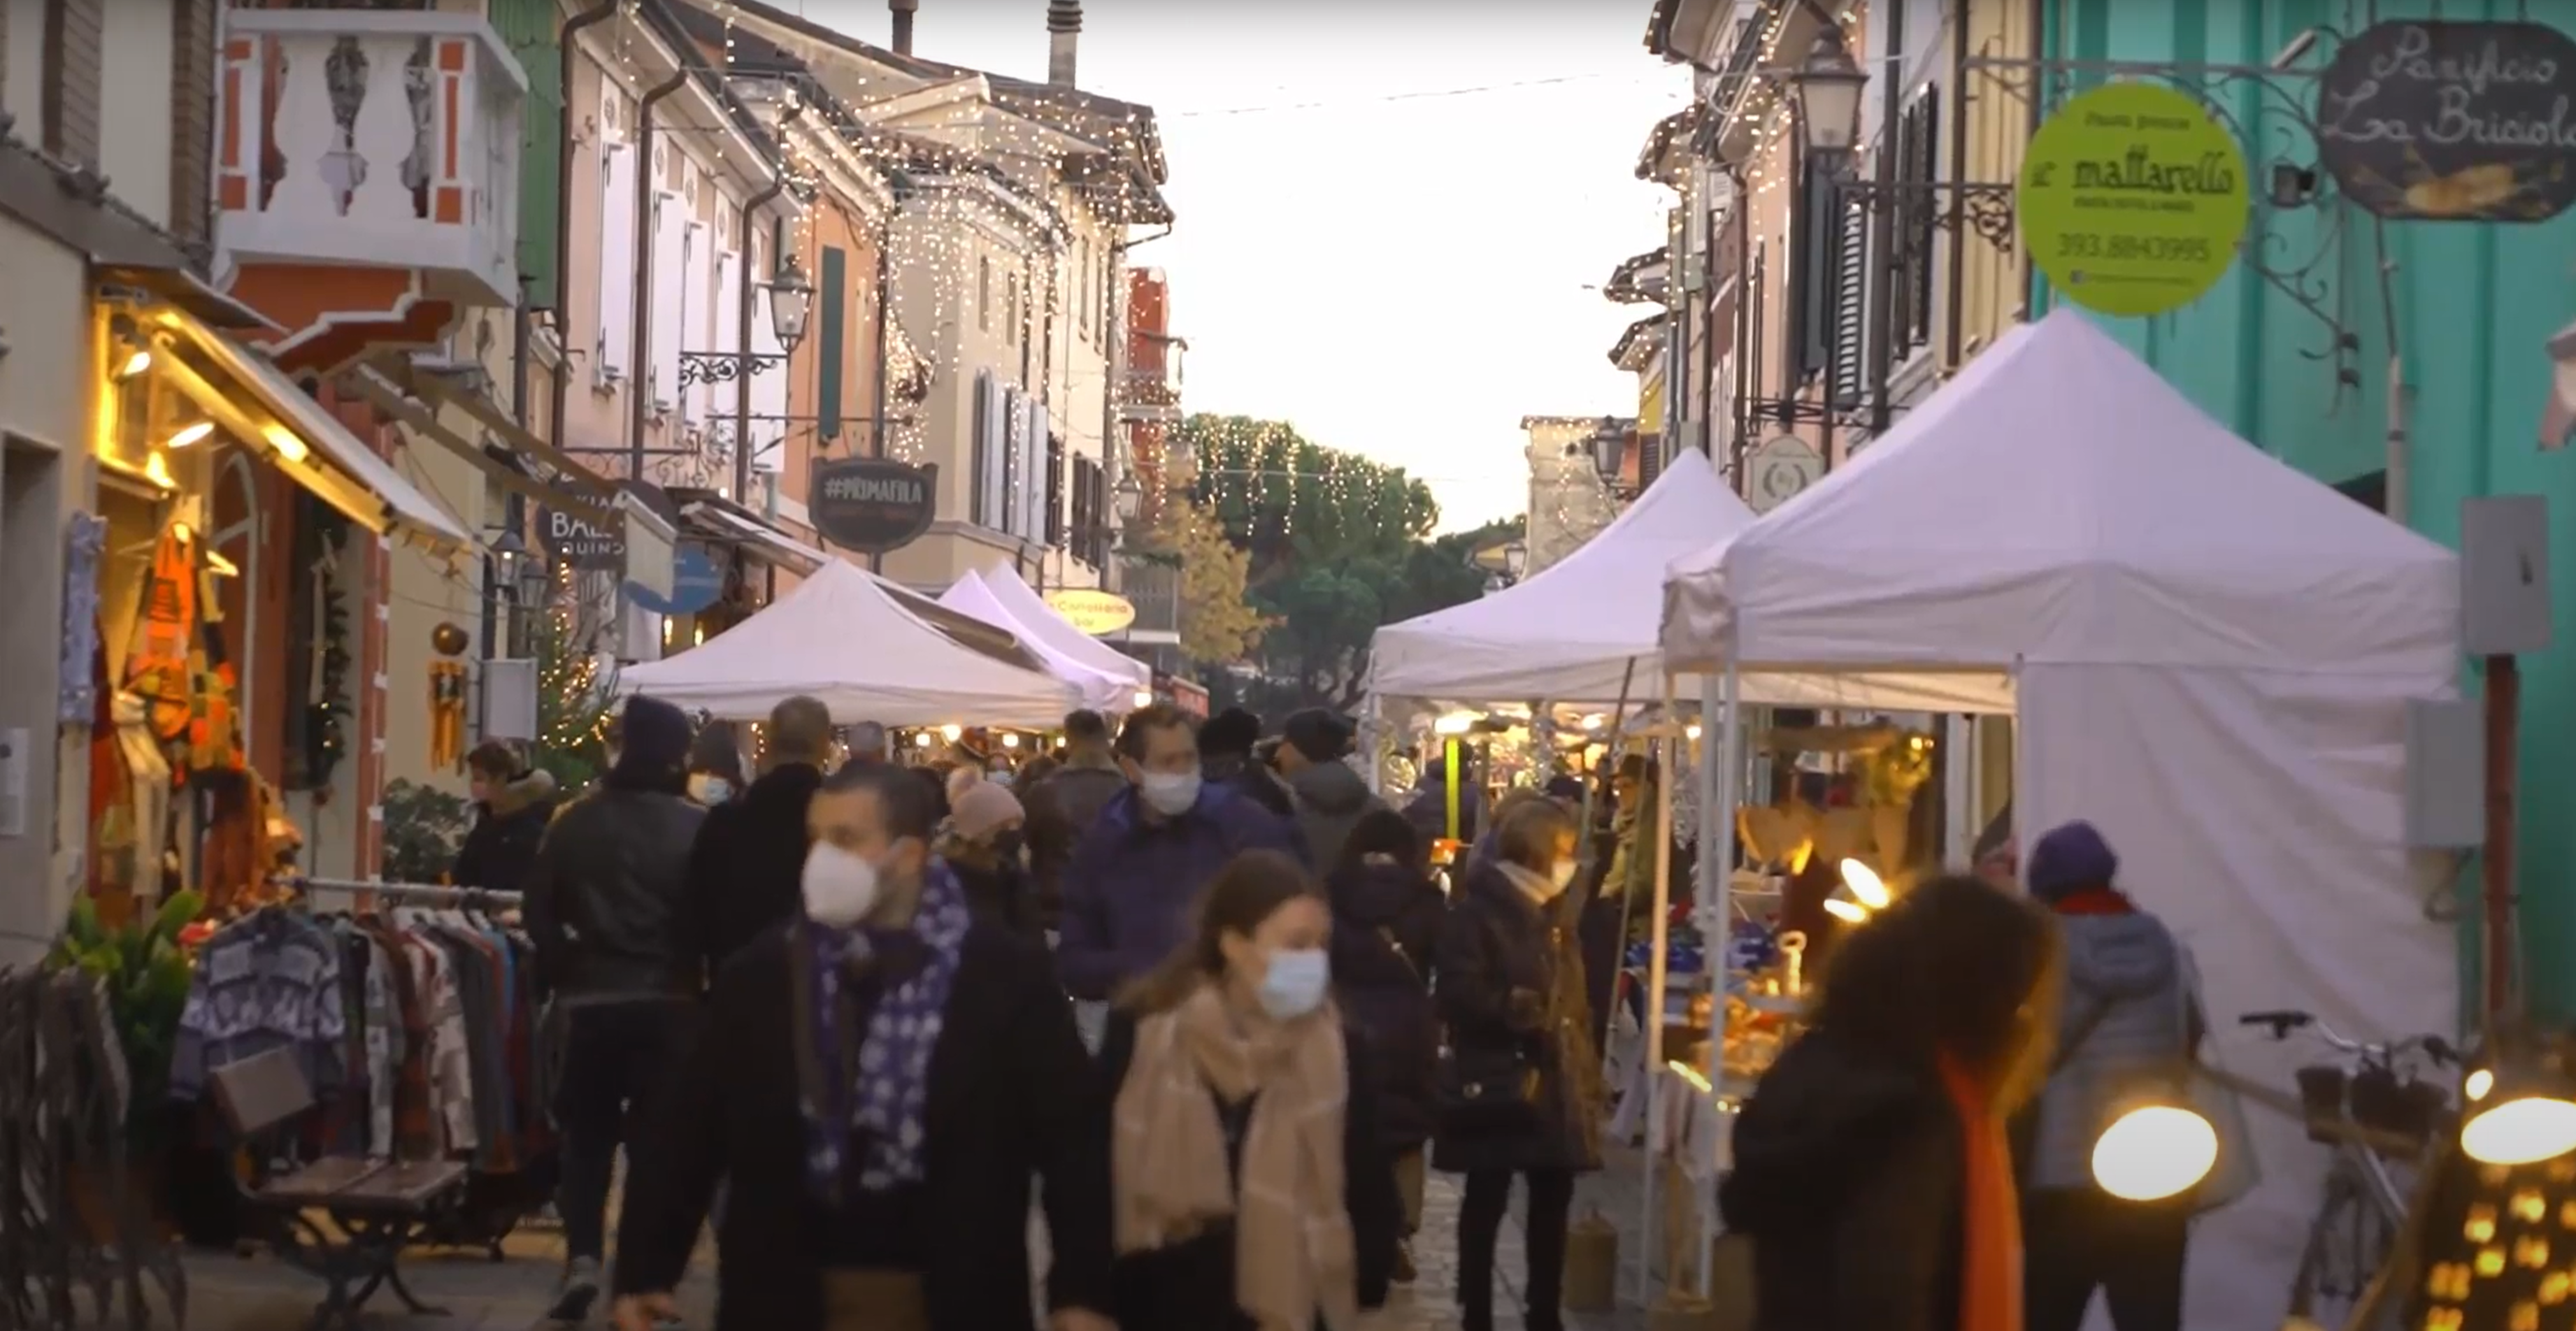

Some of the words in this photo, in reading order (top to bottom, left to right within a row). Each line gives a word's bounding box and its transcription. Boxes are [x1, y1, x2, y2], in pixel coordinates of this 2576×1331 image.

[2319, 79, 2417, 142] La
[2072, 144, 2234, 194] mattarello
[824, 477, 922, 503] #PRIMAFILA
